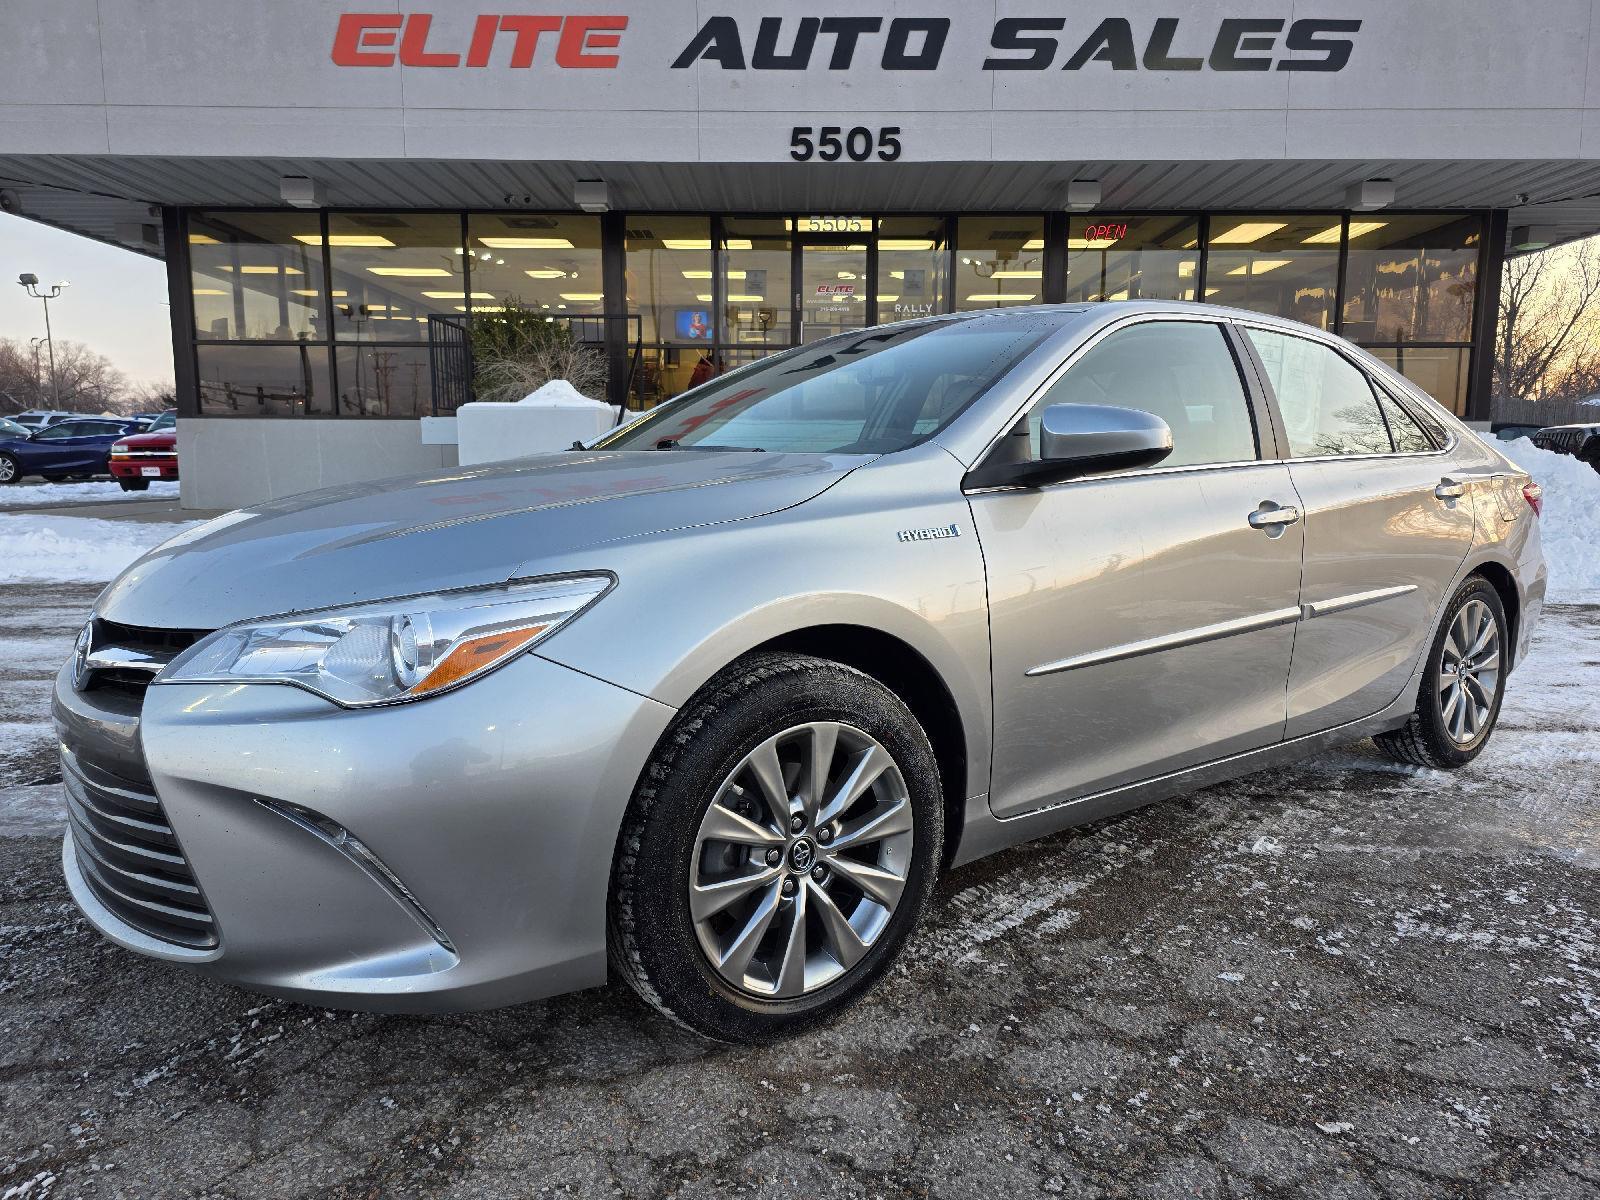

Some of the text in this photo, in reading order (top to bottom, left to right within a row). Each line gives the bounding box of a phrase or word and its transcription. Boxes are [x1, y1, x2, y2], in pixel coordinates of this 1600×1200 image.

[331, 13, 1363, 72] ELITE AUTO SALES
[790, 126, 902, 162] 5505
[808, 215, 862, 232] 5505
[1085, 223, 1127, 241] OPEN
[816, 285, 854, 293] ELITE
[895, 303, 933, 313] RALLY
[897, 526, 956, 542] HYBRID
